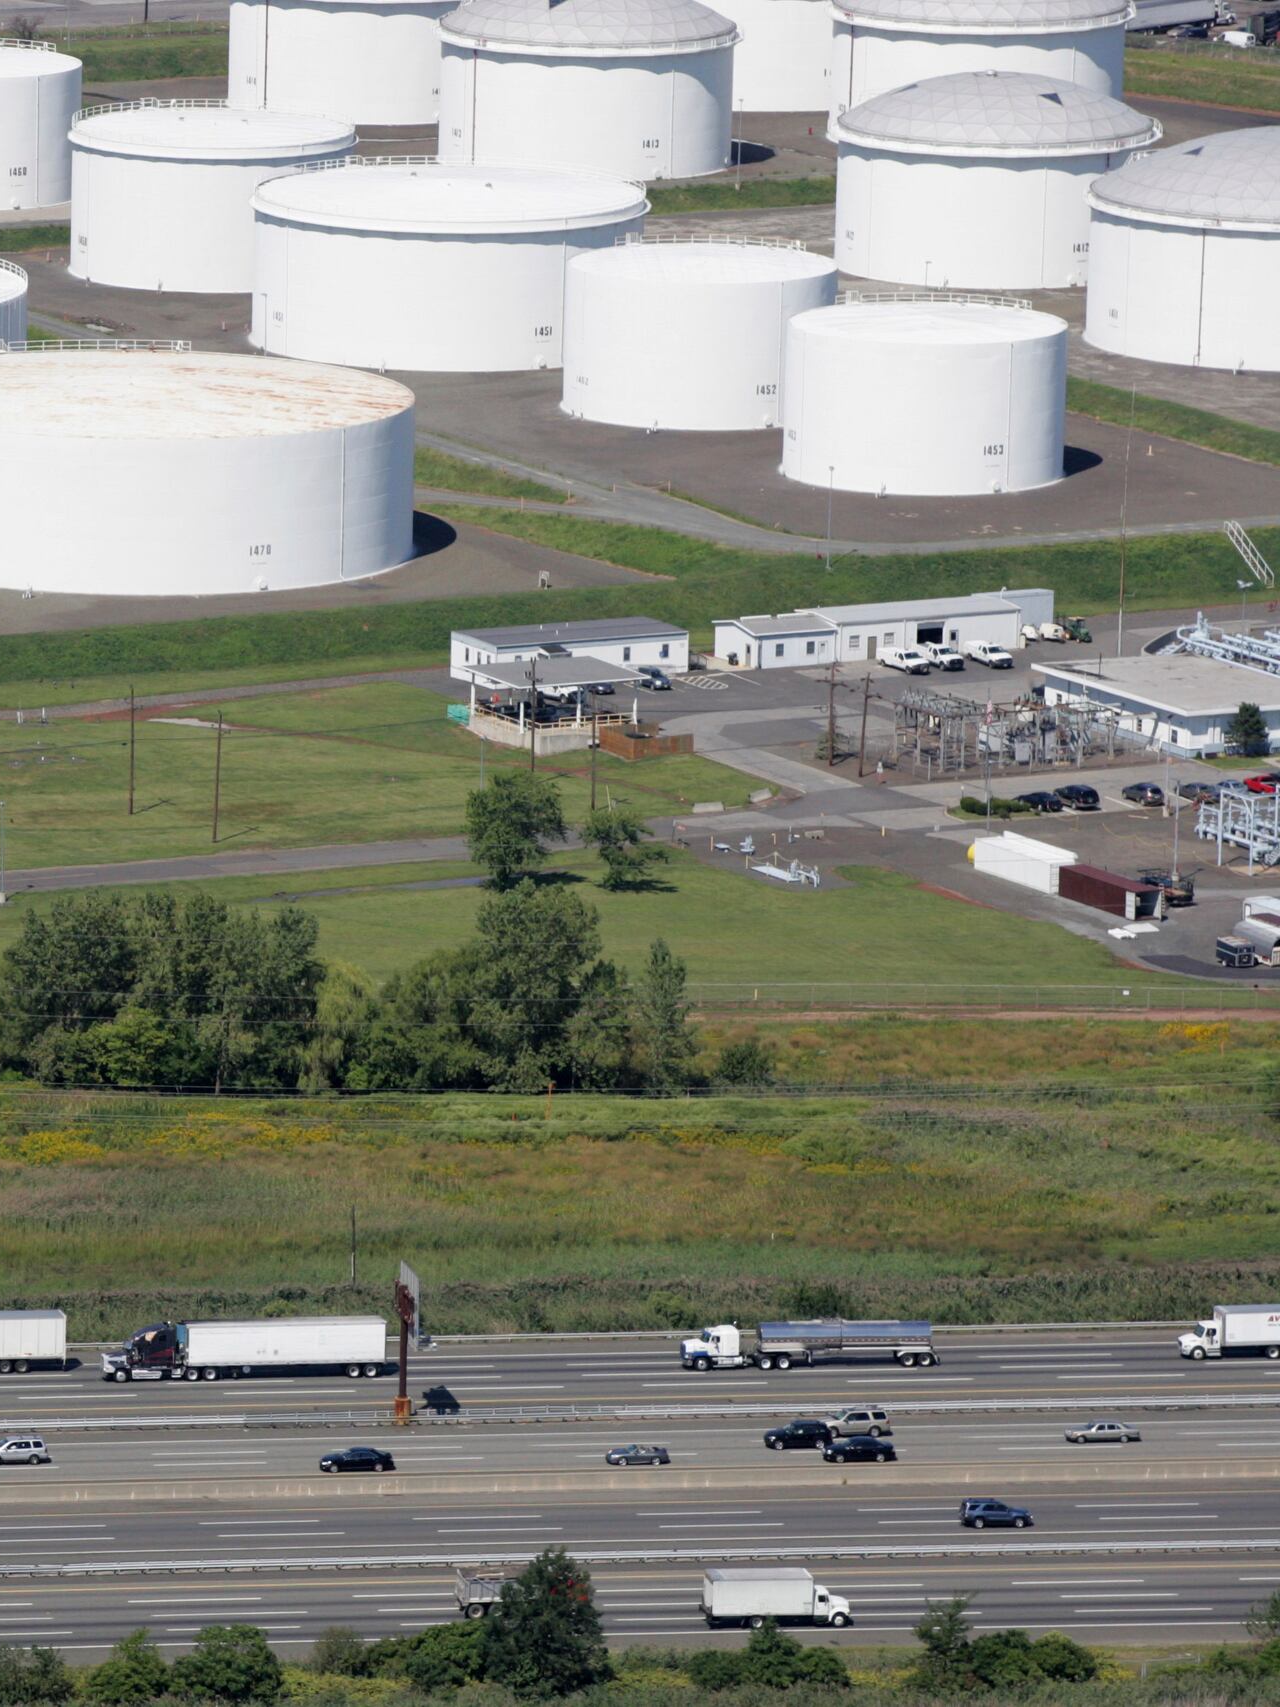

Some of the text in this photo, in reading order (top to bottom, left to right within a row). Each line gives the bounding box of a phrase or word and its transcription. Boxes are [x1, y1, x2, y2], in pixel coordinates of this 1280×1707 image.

[642, 139, 659, 149] 1413
[1073, 243, 1090, 254] 1412
[534, 325, 553, 337] 1451
[756, 384, 777, 396] 1452
[983, 445, 1005, 456] 1453
[249, 544, 271, 557] 1470
